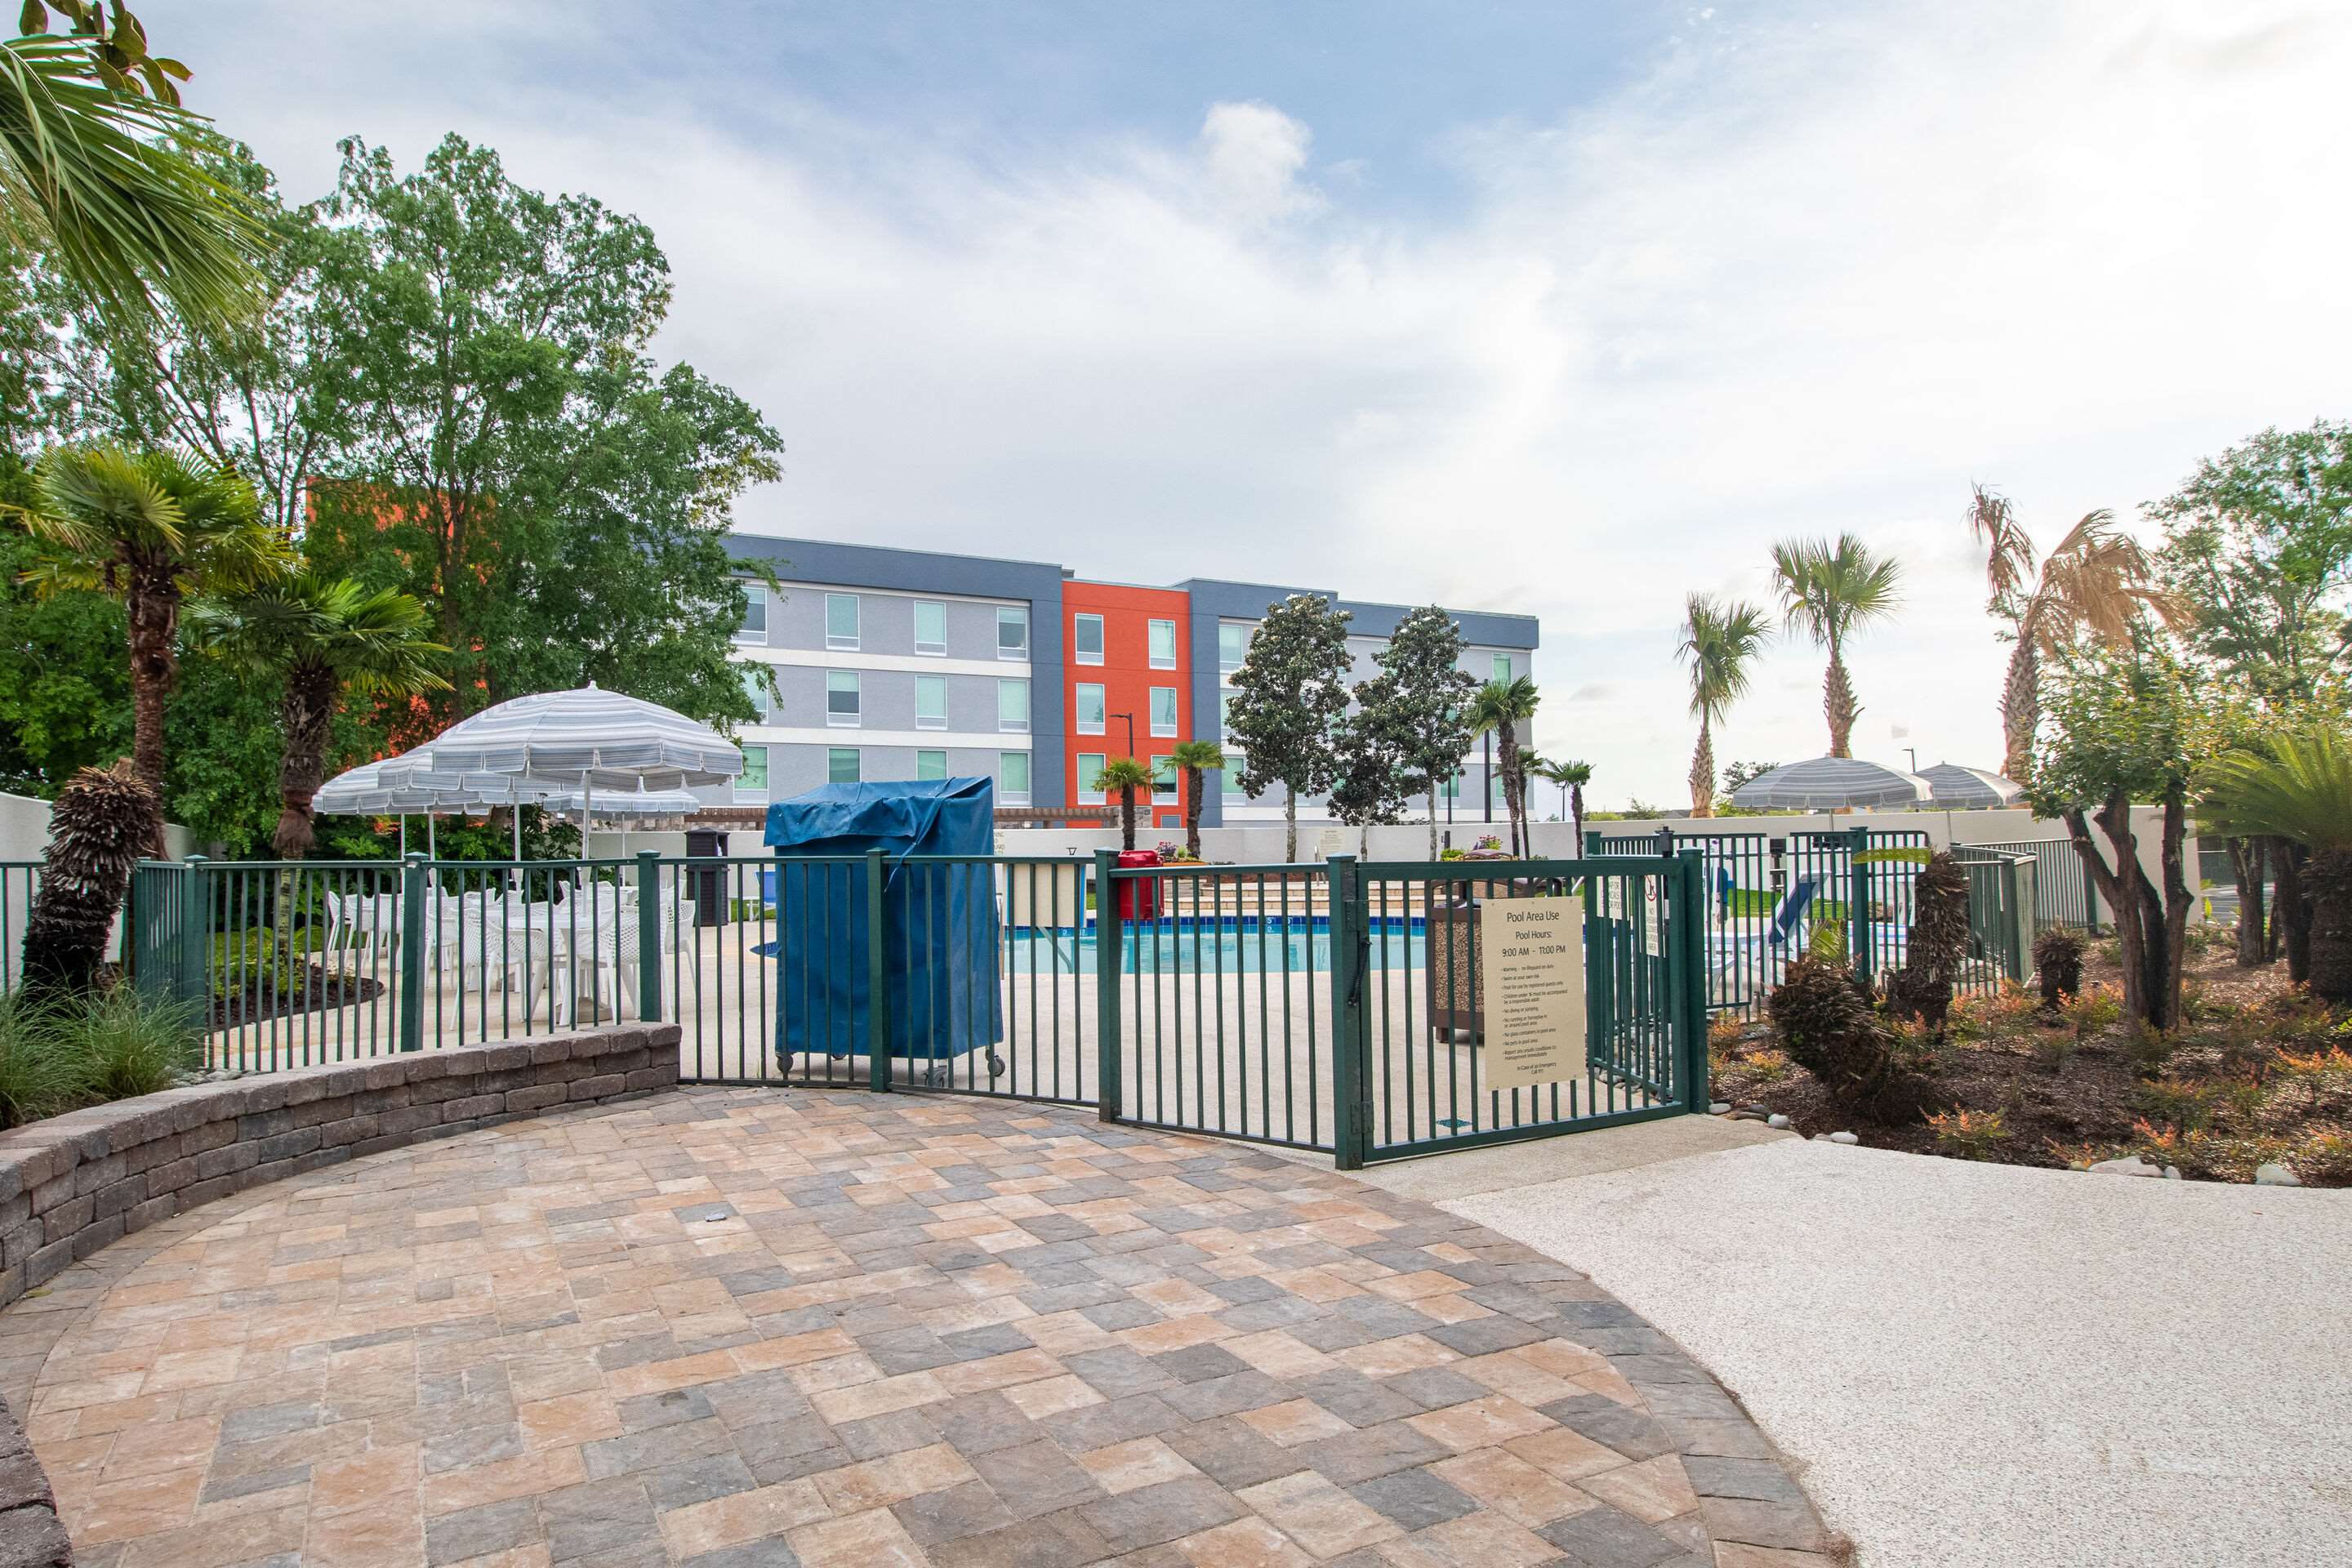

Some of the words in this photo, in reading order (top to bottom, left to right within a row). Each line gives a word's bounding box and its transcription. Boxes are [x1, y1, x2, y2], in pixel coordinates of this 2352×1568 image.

[1507, 911, 1524, 922] Pool
[1526, 911, 1544, 921] Area
[1545, 911, 1559, 921] Use
[1516, 930, 1530, 939] Pool
[1502, 948, 1517, 957] 9:00
[1518, 947, 1529, 956] AM
[1539, 946, 1554, 954] 11:00
[1556, 945, 1566, 953] PM
